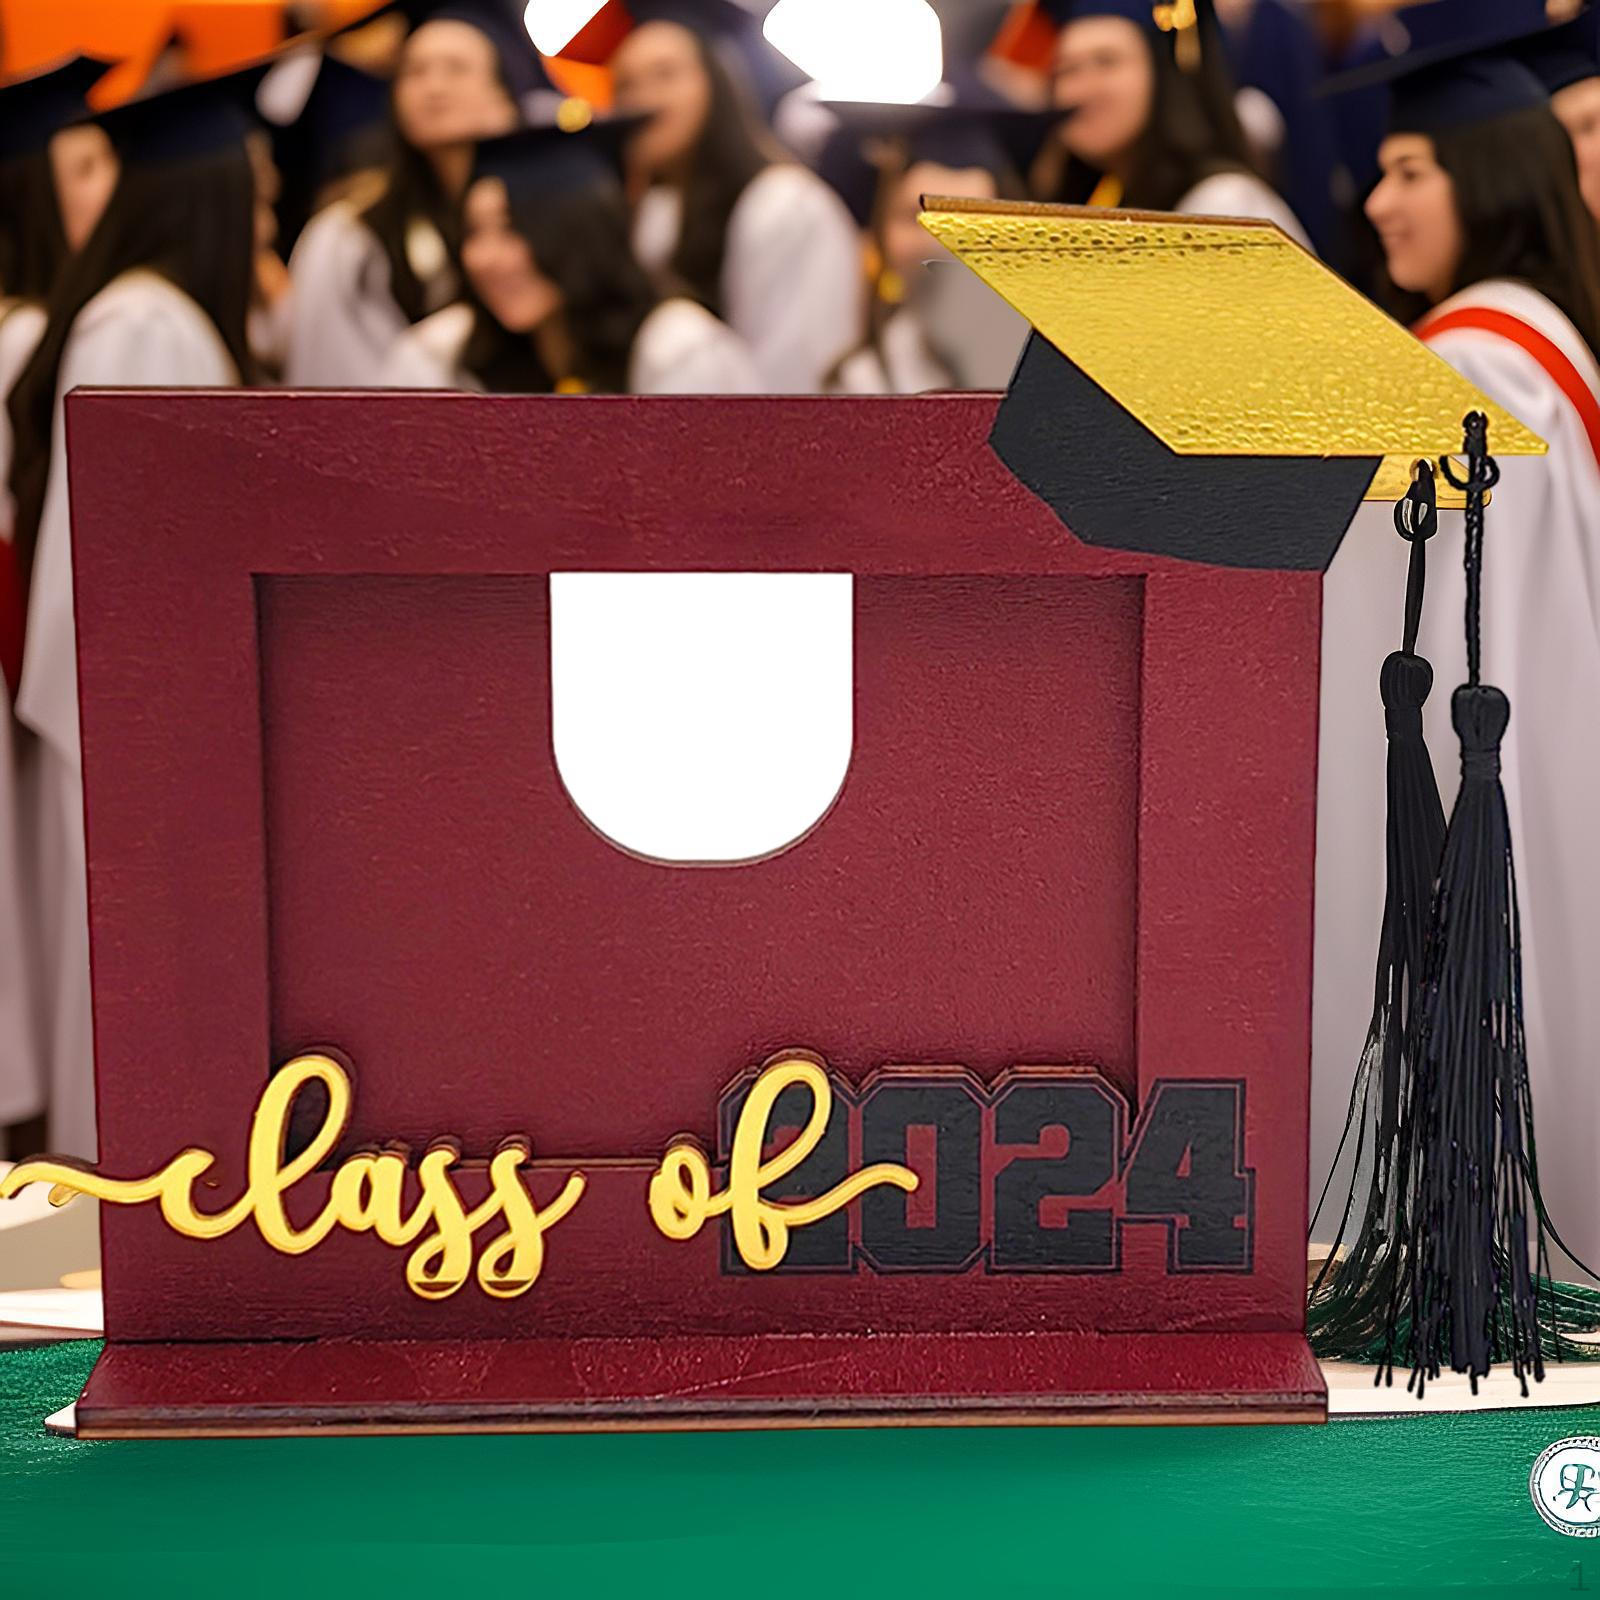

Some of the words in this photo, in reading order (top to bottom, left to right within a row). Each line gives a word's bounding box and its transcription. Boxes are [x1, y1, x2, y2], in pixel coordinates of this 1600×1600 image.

[0, 1054, 587, 1300] class
[649, 1056, 919, 1271] of
[718, 1070, 1256, 1275] 2024
